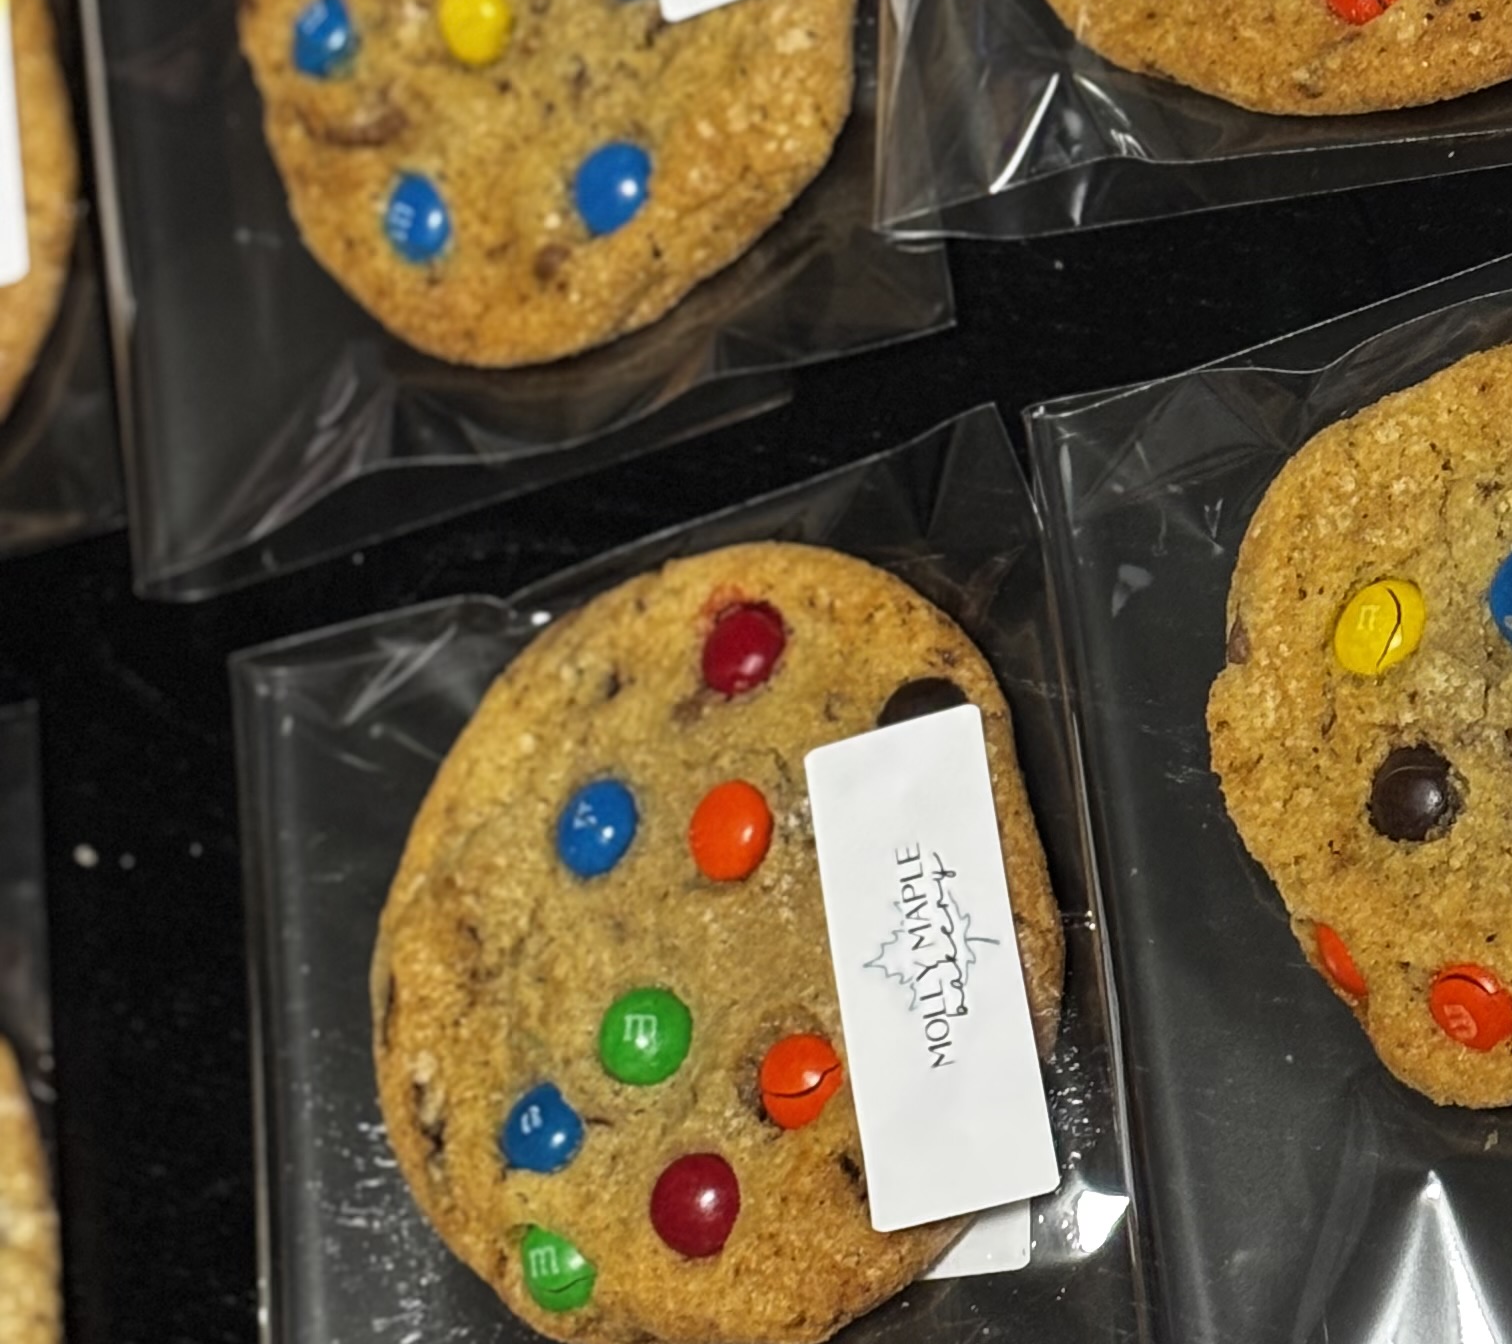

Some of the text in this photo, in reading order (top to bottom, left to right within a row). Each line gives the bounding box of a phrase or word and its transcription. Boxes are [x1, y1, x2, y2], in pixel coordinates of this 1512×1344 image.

[895, 841, 956, 1069] MOLLY MAPLE
[932, 852, 969, 1016] bakery
[624, 1014, 657, 1043] m
[529, 1247, 560, 1277] m
